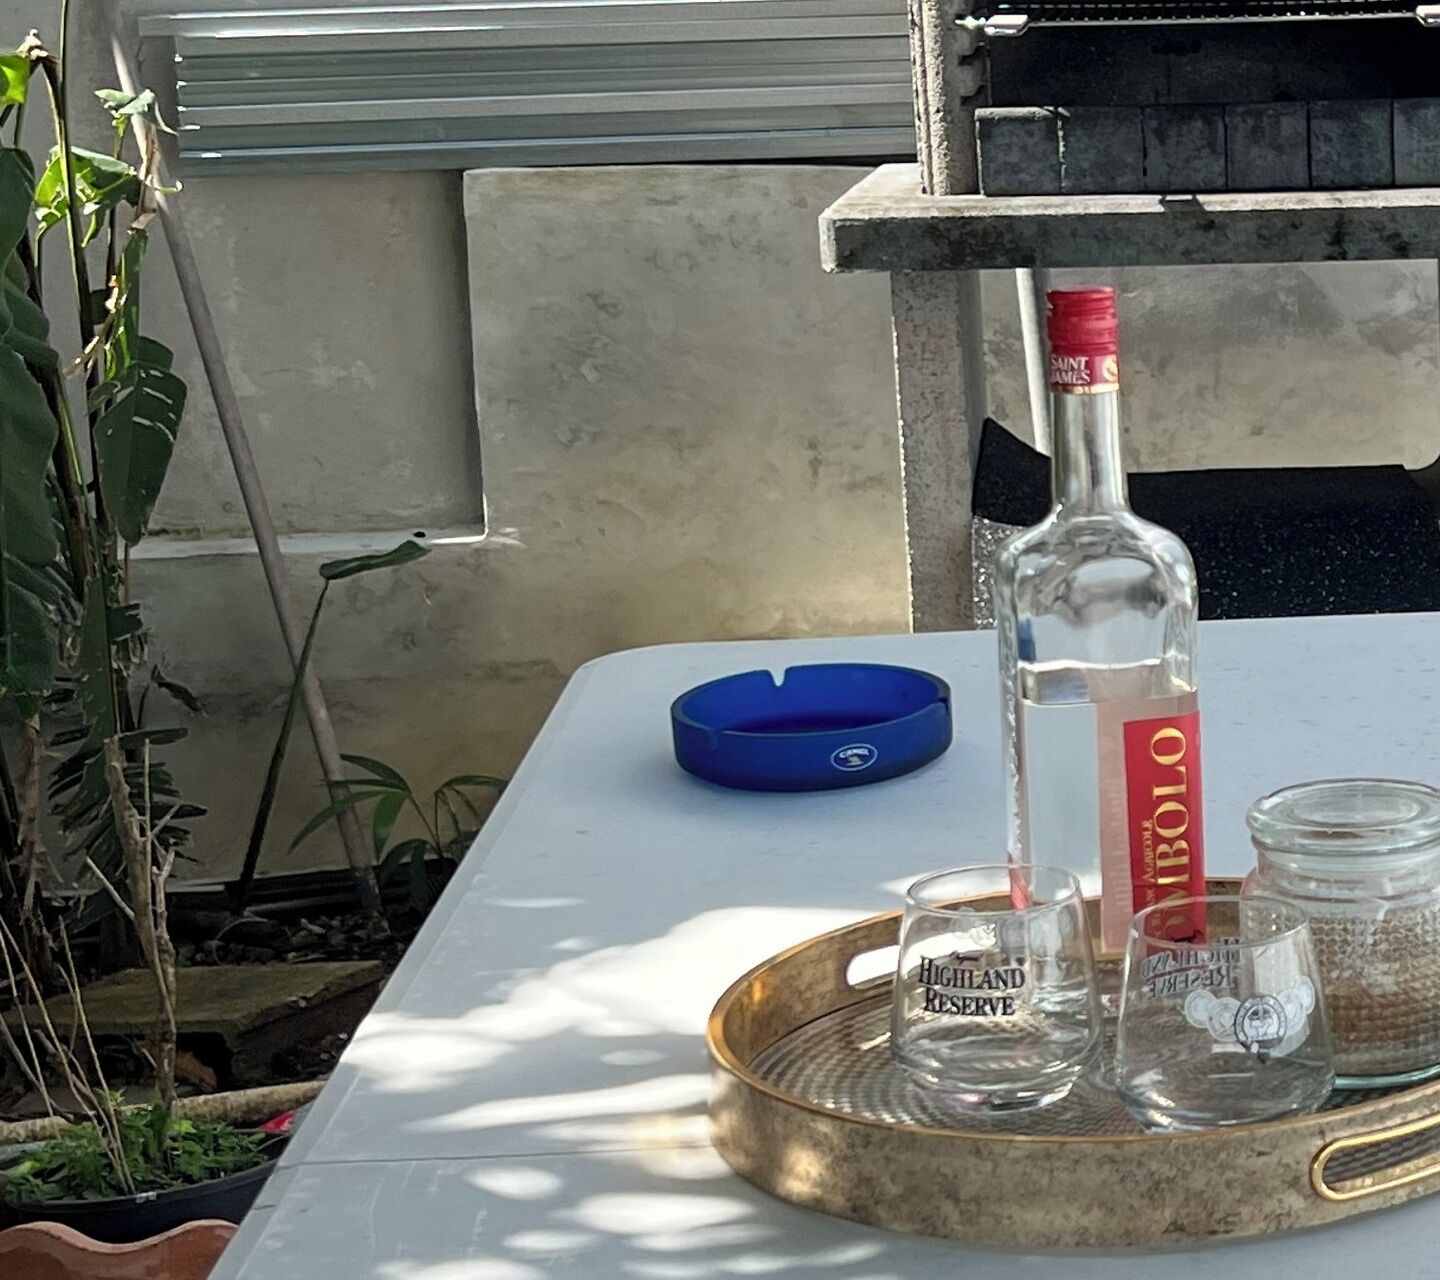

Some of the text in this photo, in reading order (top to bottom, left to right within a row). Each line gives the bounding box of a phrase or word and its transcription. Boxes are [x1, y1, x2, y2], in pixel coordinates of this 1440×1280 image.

[1050, 355, 1089, 371] SAINT
[918, 955, 1026, 991] HIGHLAND
[923, 987, 1016, 1016] RESERVE
